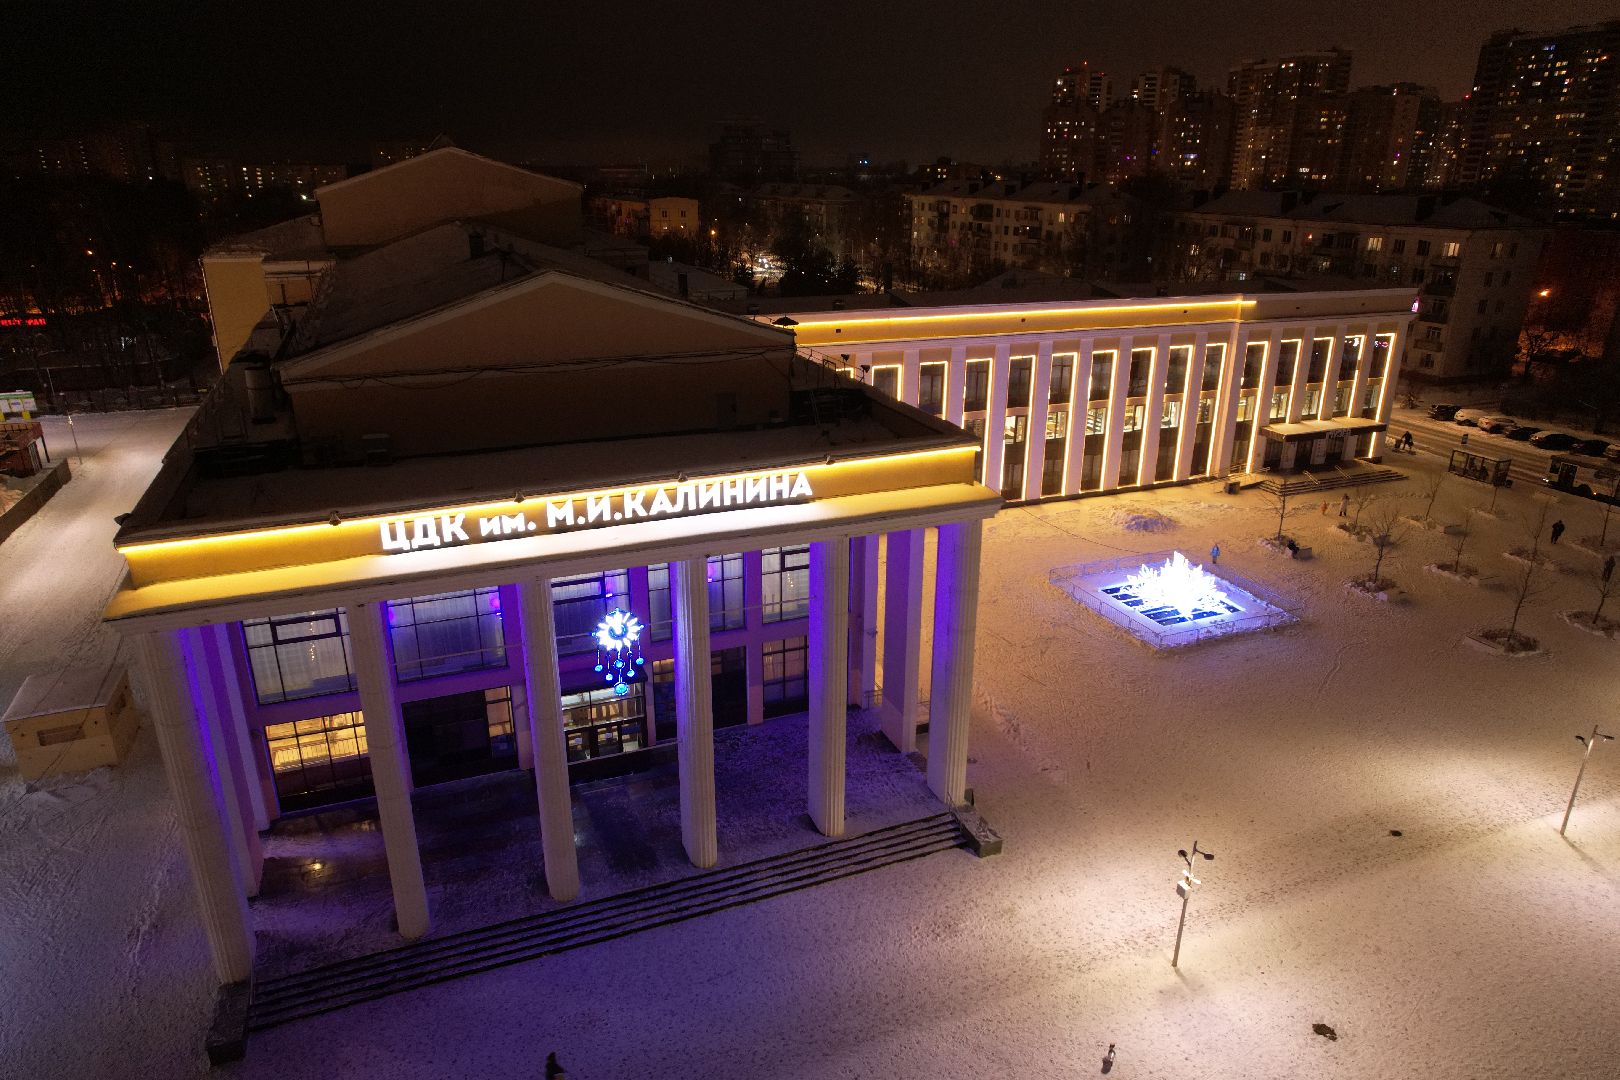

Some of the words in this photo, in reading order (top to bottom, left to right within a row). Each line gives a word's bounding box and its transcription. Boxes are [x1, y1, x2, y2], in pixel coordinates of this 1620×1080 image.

[379, 512, 469, 551] ЦДК
[479, 512, 537, 537] им.
[546, 472, 813, 528] М.И.КАЛИНИНА
